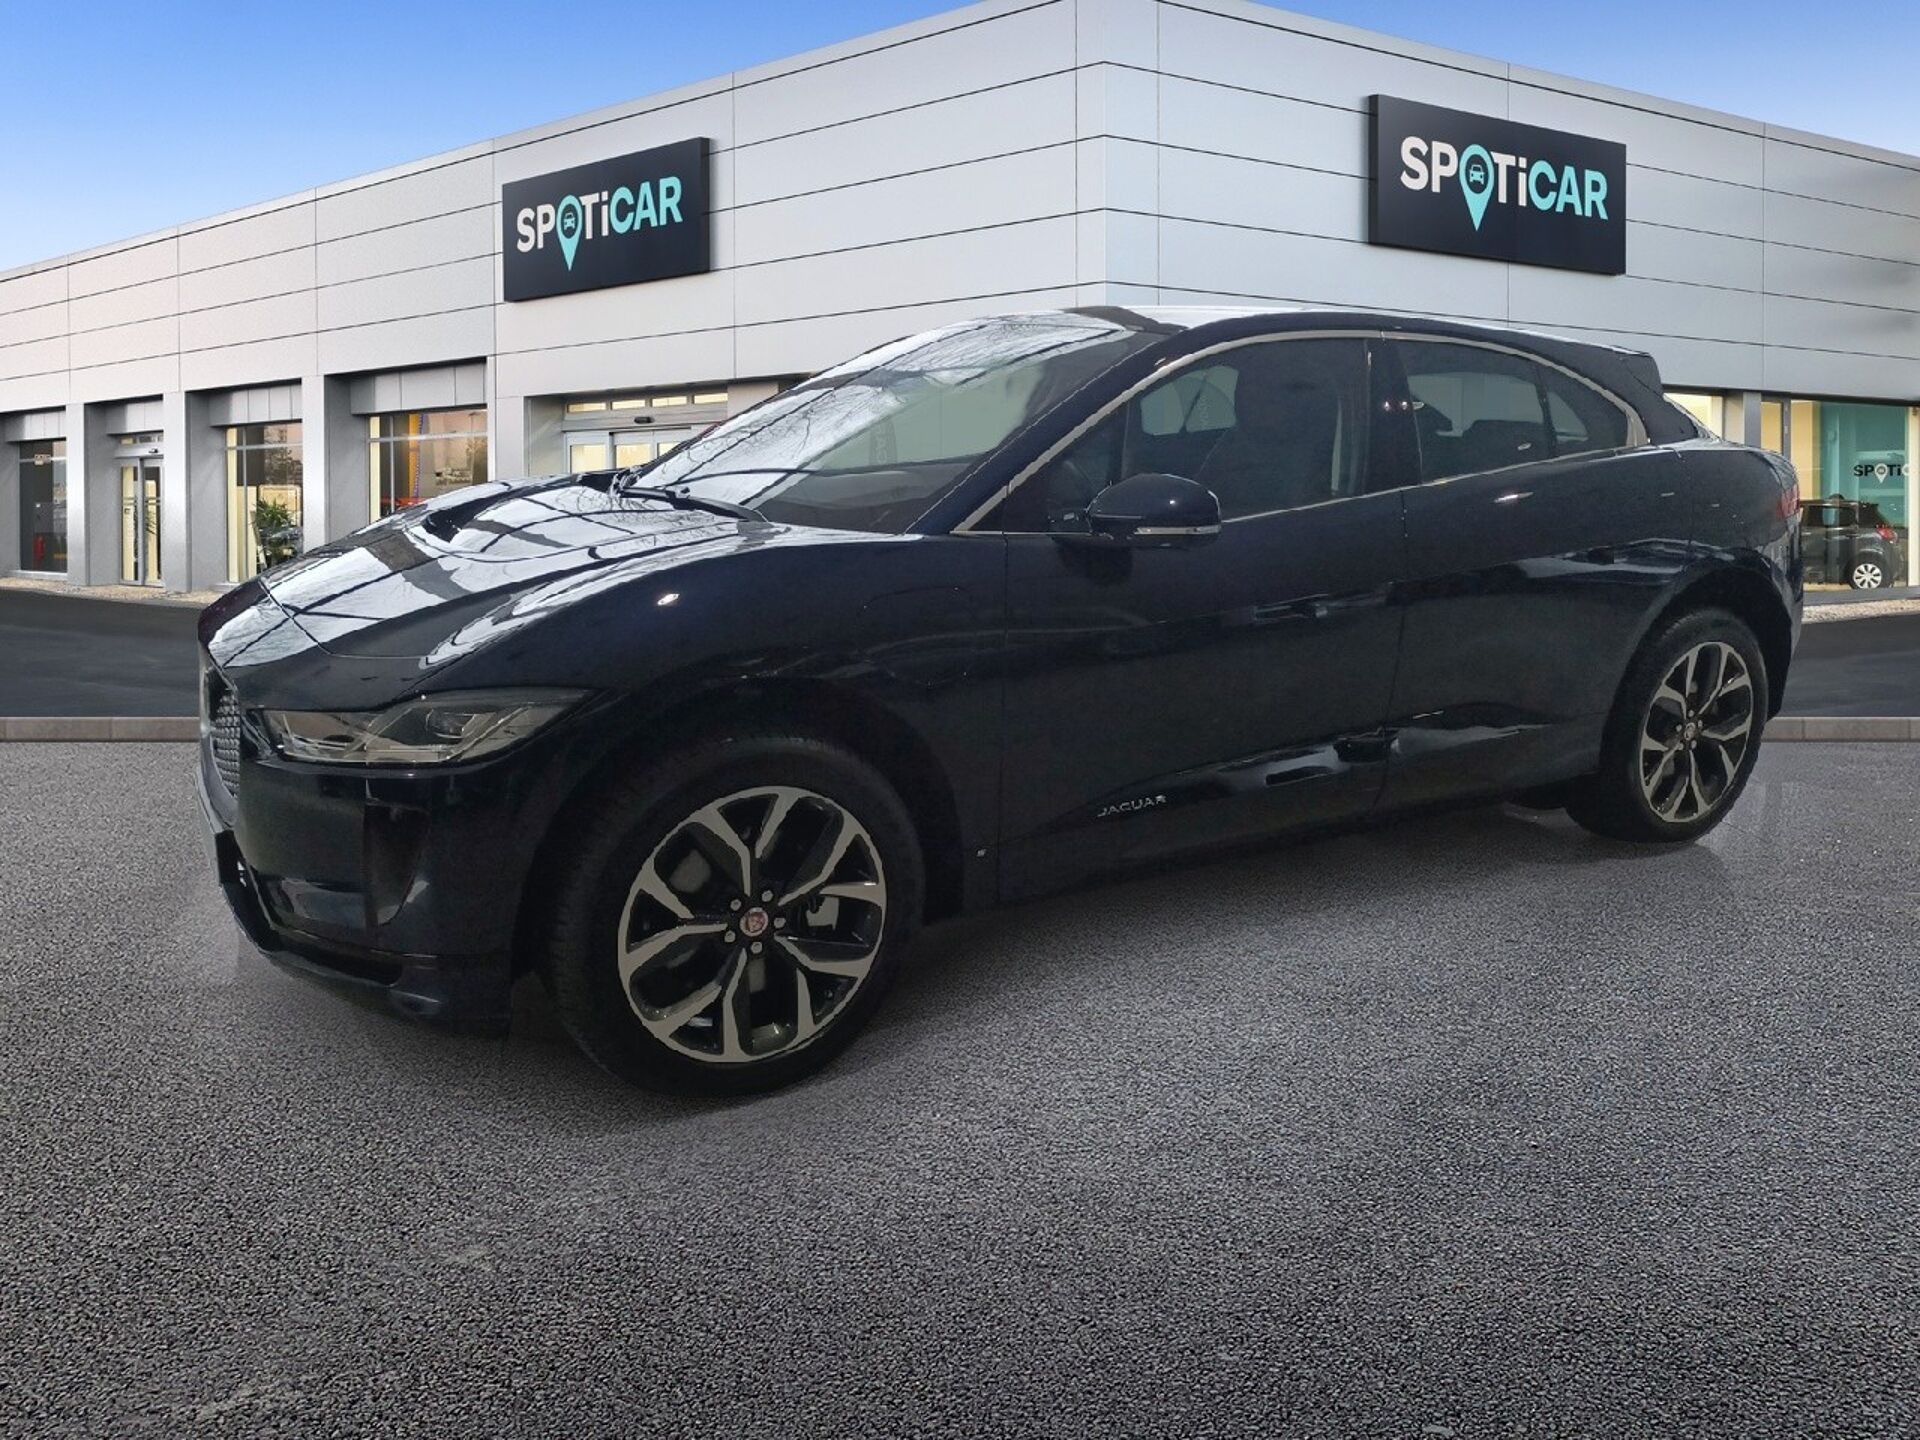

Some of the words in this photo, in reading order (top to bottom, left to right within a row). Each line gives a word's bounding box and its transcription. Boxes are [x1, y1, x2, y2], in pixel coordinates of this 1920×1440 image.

[516, 176, 683, 271] SPOTiCAR
[1400, 136, 1608, 231] SPOTiCAR
[1097, 794, 1167, 817] JAGUAR
